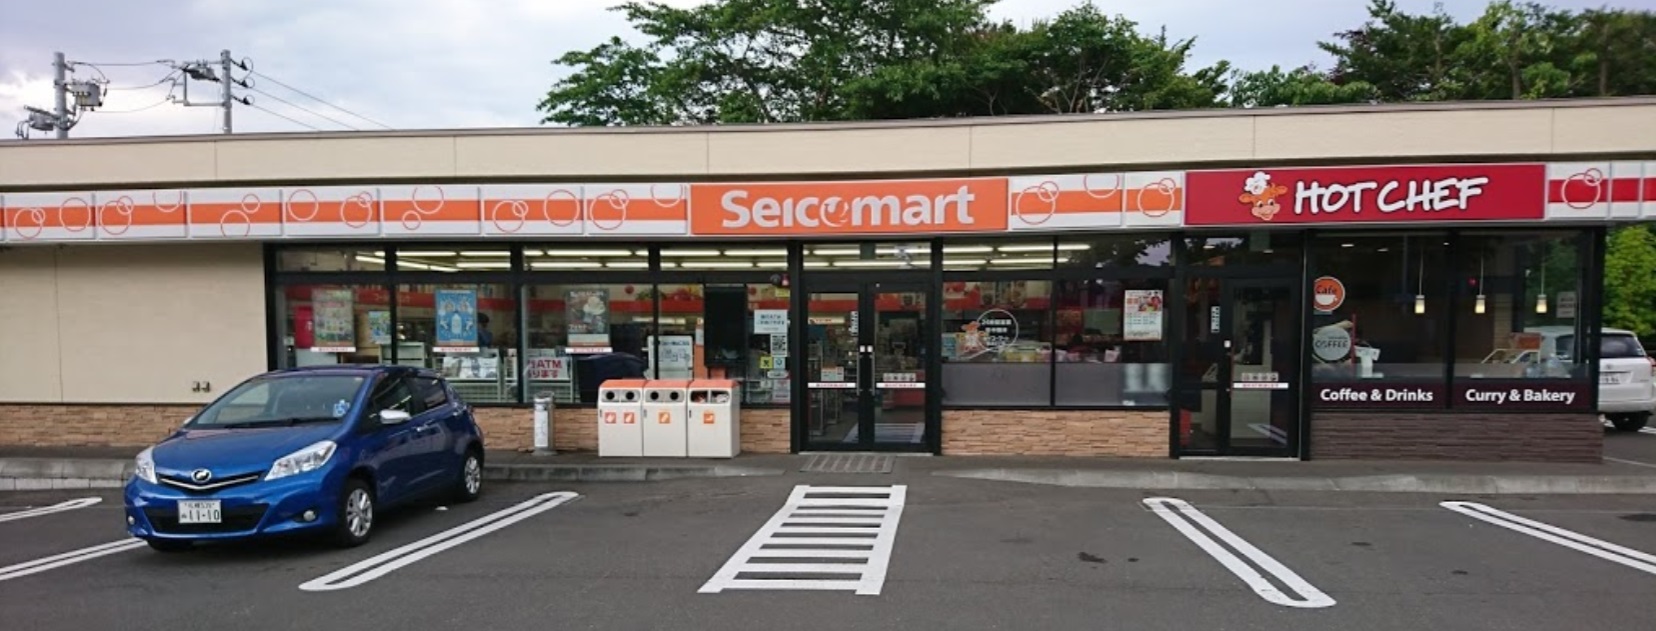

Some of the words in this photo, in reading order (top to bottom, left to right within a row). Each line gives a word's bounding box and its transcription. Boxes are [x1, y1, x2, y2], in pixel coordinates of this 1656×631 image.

[1294, 180, 1377, 214] HOT
[1376, 176, 1488, 212] CHEF
[721, 185, 975, 228] Seicomart
[1315, 339, 1349, 349] COFFEE
[1320, 387, 1368, 402] Coffee
[1370, 388, 1383, 402] &
[1385, 387, 1434, 402] Drinks
[1465, 388, 1506, 404] Curry
[1508, 388, 1521, 402] &
[1524, 387, 1576, 404] Bakery
